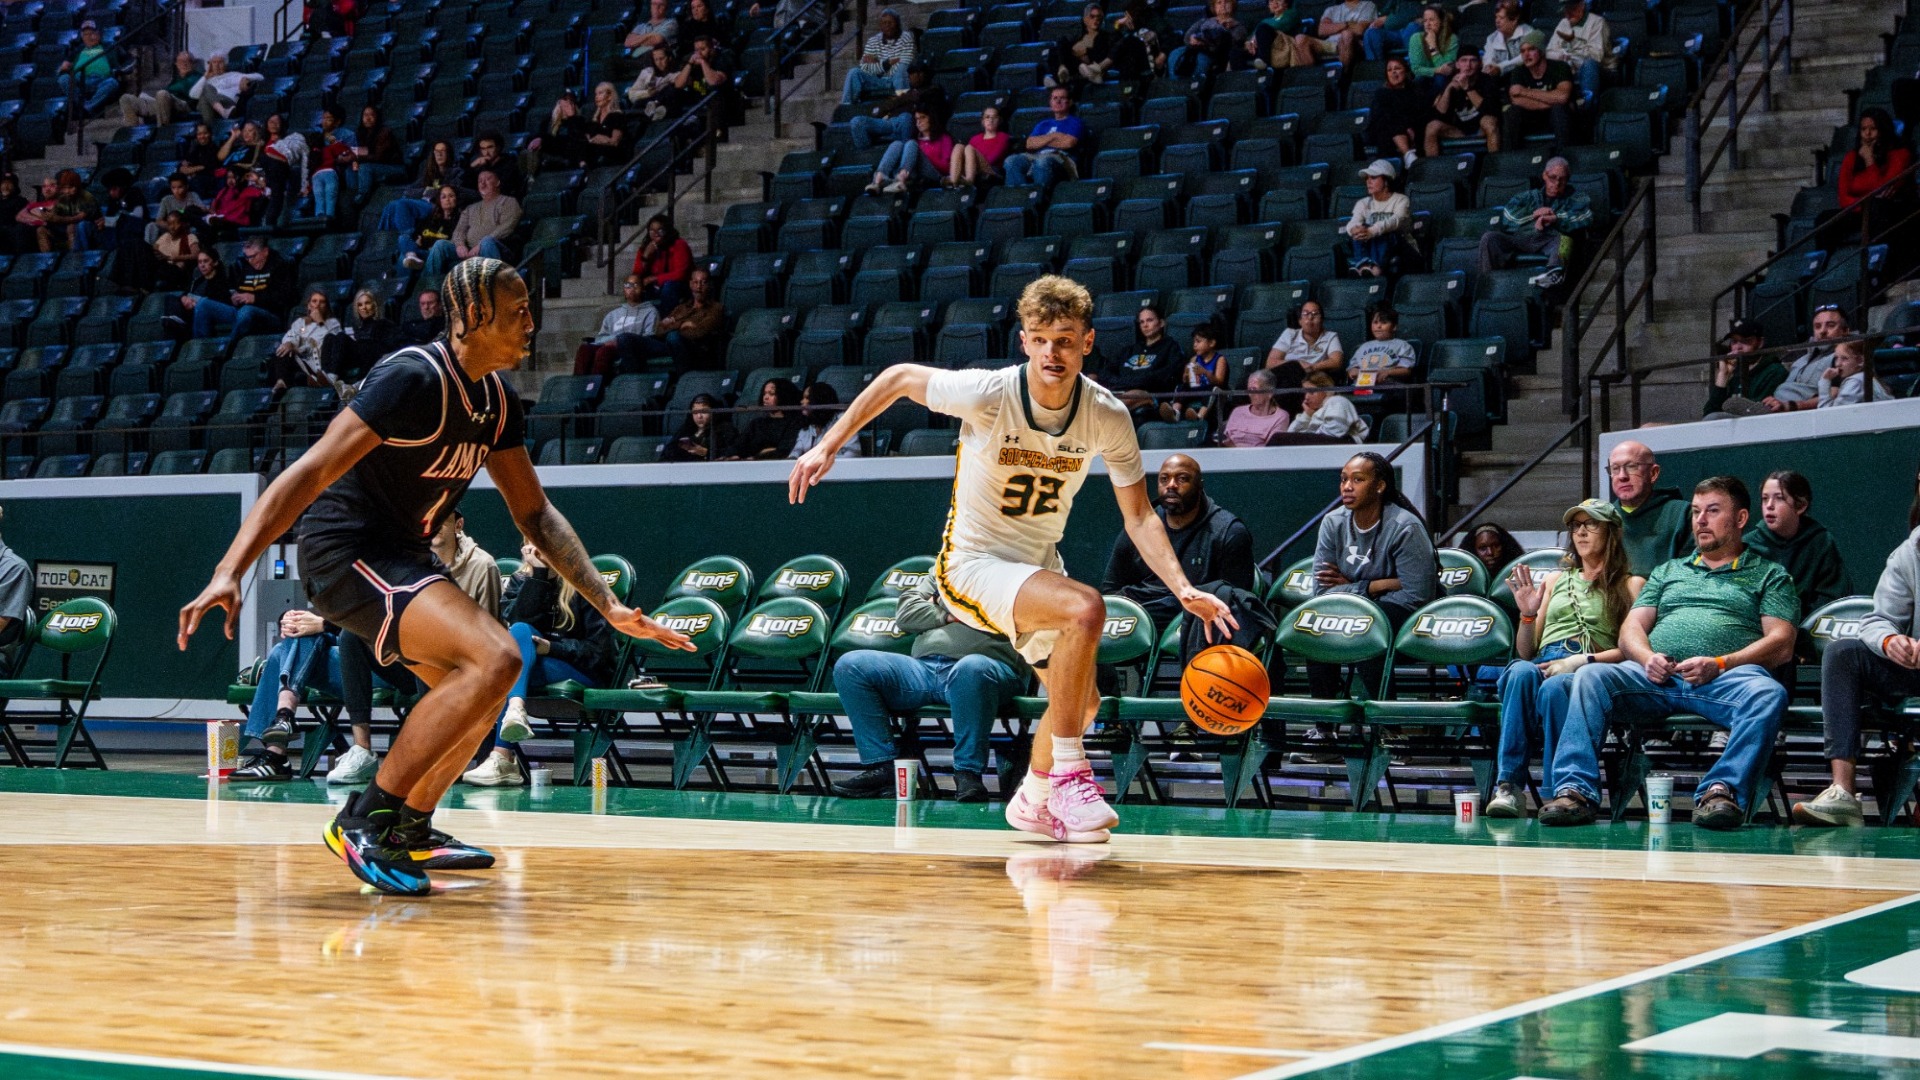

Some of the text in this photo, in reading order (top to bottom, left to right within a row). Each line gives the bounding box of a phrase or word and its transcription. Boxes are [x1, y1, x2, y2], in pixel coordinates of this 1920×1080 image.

[998, 447, 1084, 473] SOUTHEASTERN
[1001, 474, 1066, 516] 32
[40, 572, 108, 587] TOP CAT
[850, 615, 901, 635] Lion
[1207, 686, 1248, 714] NCAA
